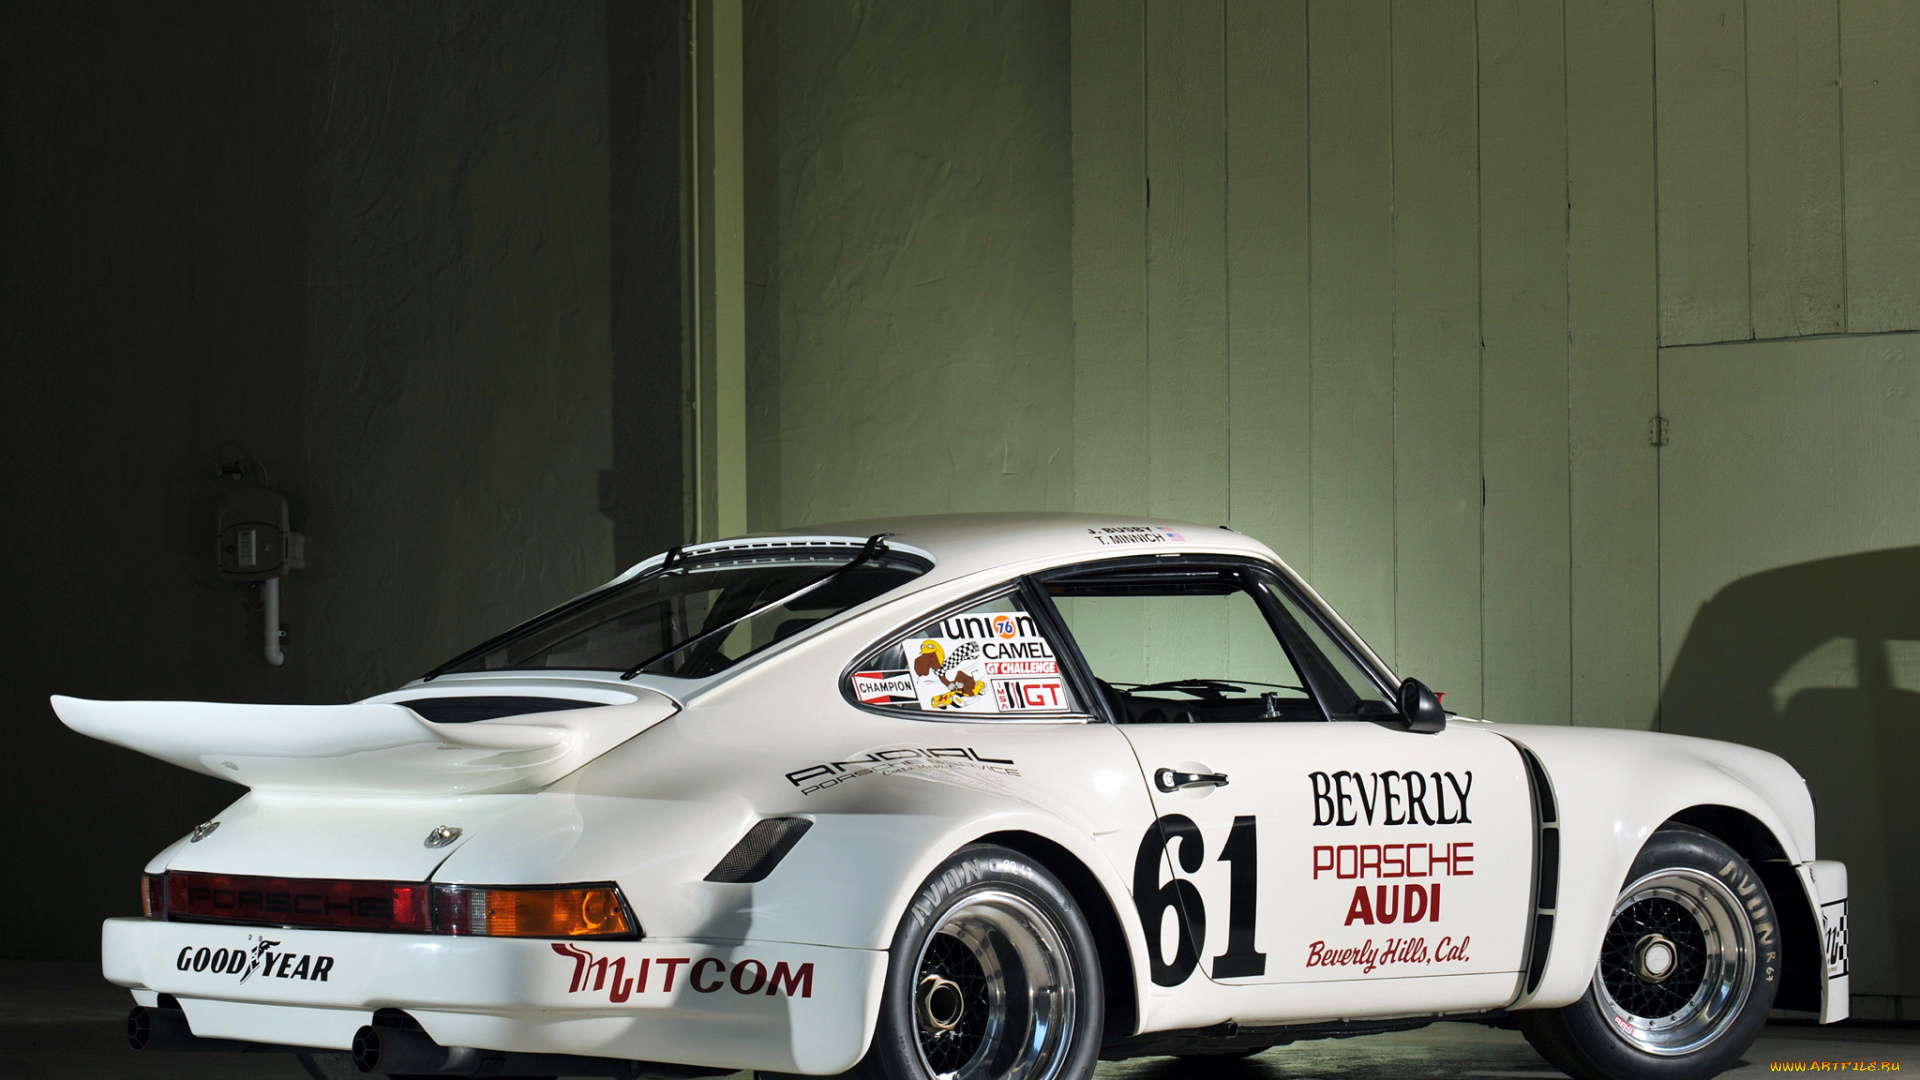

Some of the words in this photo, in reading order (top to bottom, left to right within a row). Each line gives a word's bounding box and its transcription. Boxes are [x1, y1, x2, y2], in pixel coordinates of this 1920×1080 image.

[1094, 536, 1110, 545] T.
[1109, 533, 1166, 545] MINNICH
[982, 642, 1053, 660] CAMEL
[985, 663, 1001, 674] GT
[1002, 662, 1056, 674] CHALLENGE
[859, 680, 912, 693] CHAMPION
[1023, 683, 1060, 706] GT
[785, 747, 1014, 787] ANDIAL
[800, 759, 916, 796] PORSCHE
[1308, 770, 1473, 826] BEVERLY
[1312, 842, 1474, 879] PORSCHE
[189, 888, 391, 917] PORSCHE
[909, 858, 984, 928] AVON
[1133, 813, 1267, 987] 61
[1344, 883, 1440, 926] AUDI
[551, 942, 814, 1003] MITCOM
[1306, 939, 1378, 975] Beverly
[1379, 936, 1432, 965] Hills,
[1434, 935, 1471, 963] Cal.
